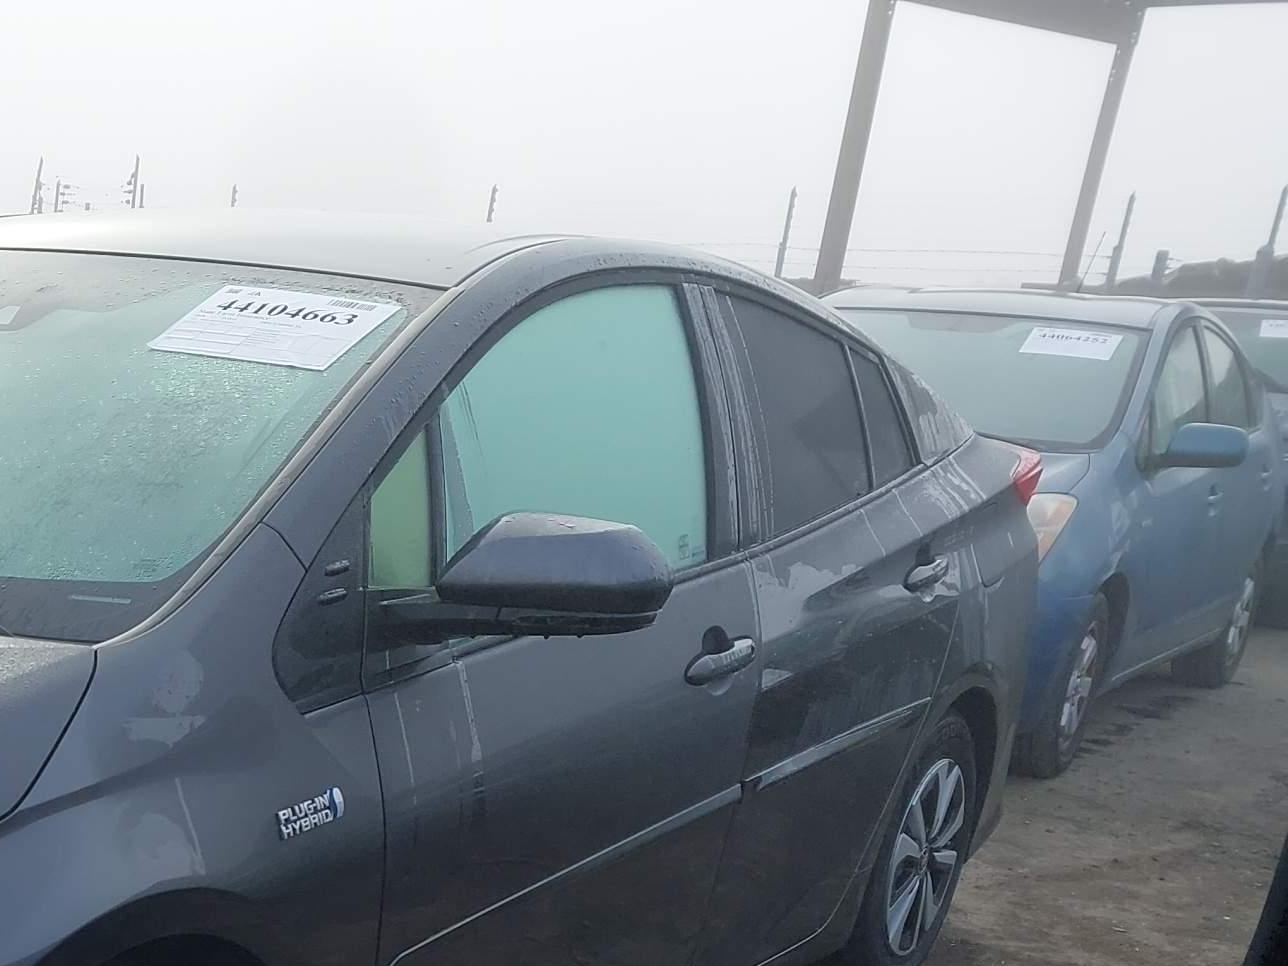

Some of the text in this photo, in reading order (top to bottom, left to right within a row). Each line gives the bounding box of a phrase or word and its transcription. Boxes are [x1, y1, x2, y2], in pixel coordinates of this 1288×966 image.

[216, 299, 360, 326] 44104663
[278, 789, 330, 824] PLUG-IN
[280, 808, 334, 839] HYBRID
